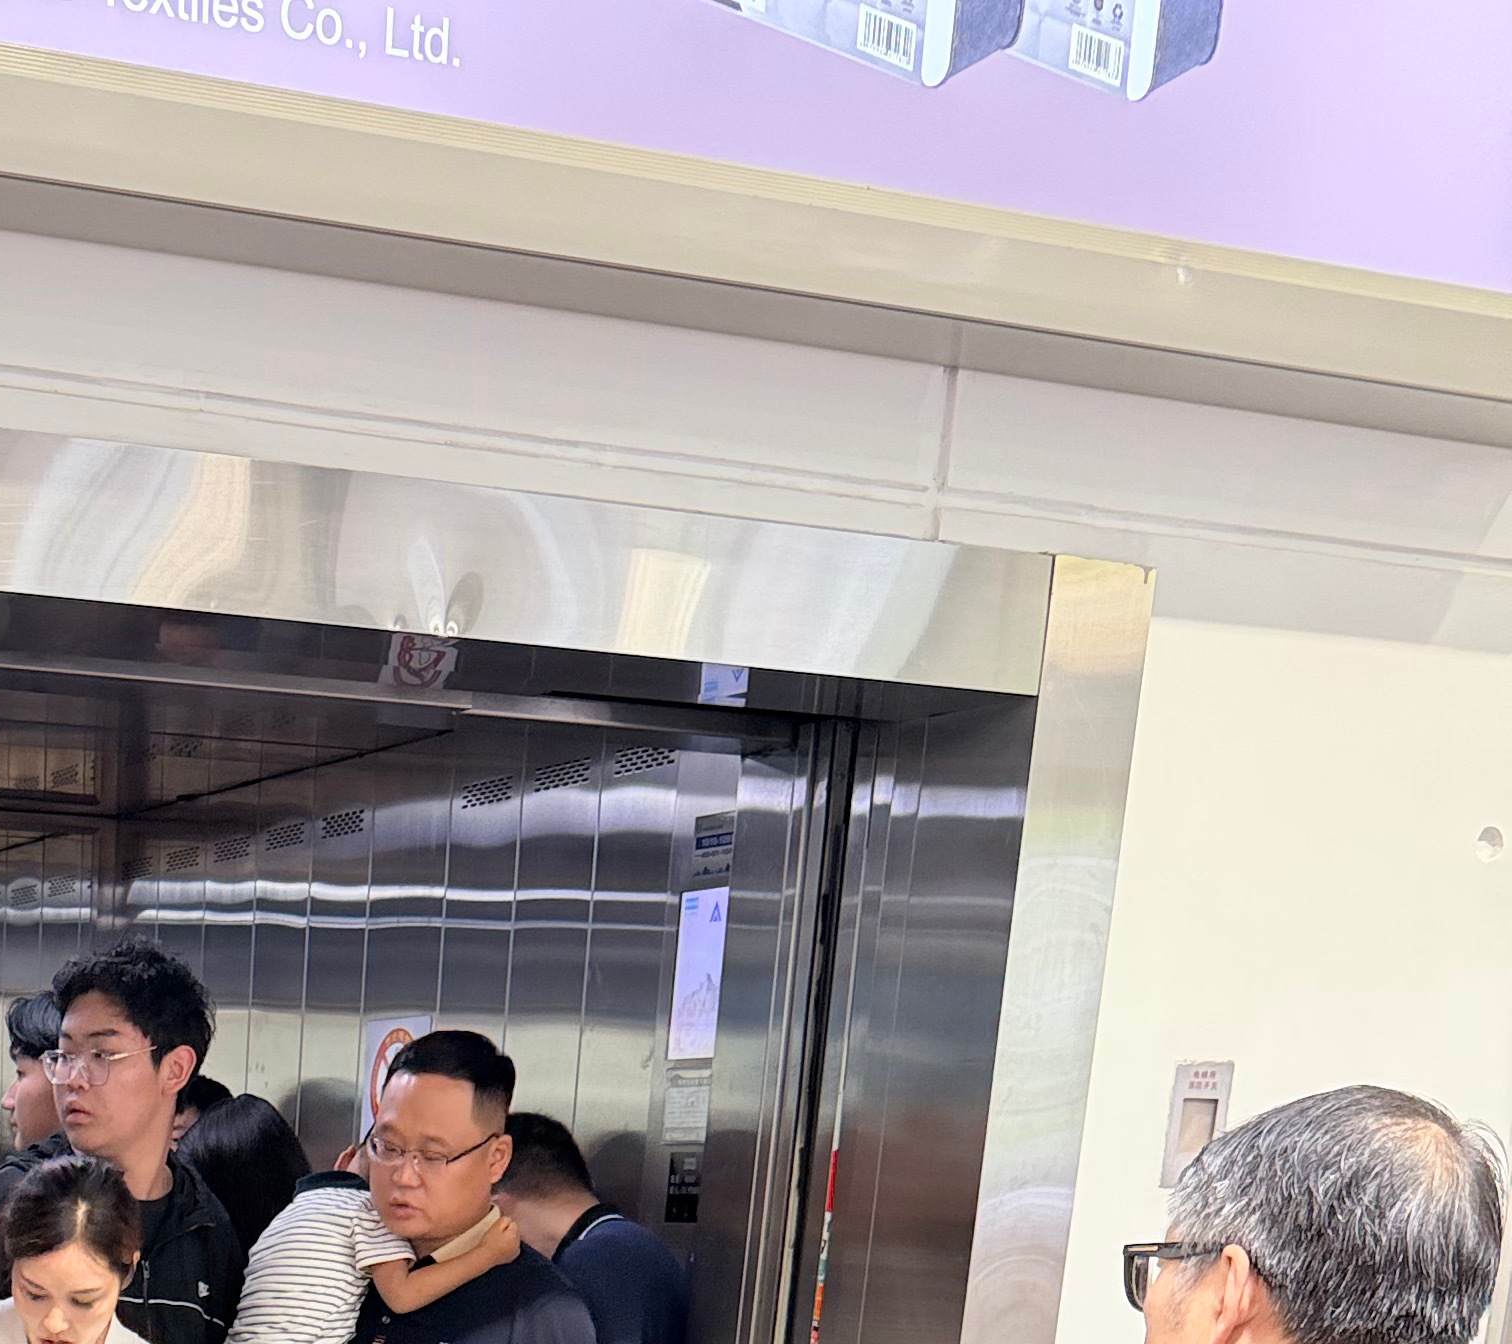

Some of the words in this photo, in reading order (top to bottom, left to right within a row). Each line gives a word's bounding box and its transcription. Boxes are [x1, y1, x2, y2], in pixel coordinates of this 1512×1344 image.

[107, 0, 265, 33] xtiles
[280, 0, 367, 59] Co.,
[385, 6, 461, 67] Ltd.
